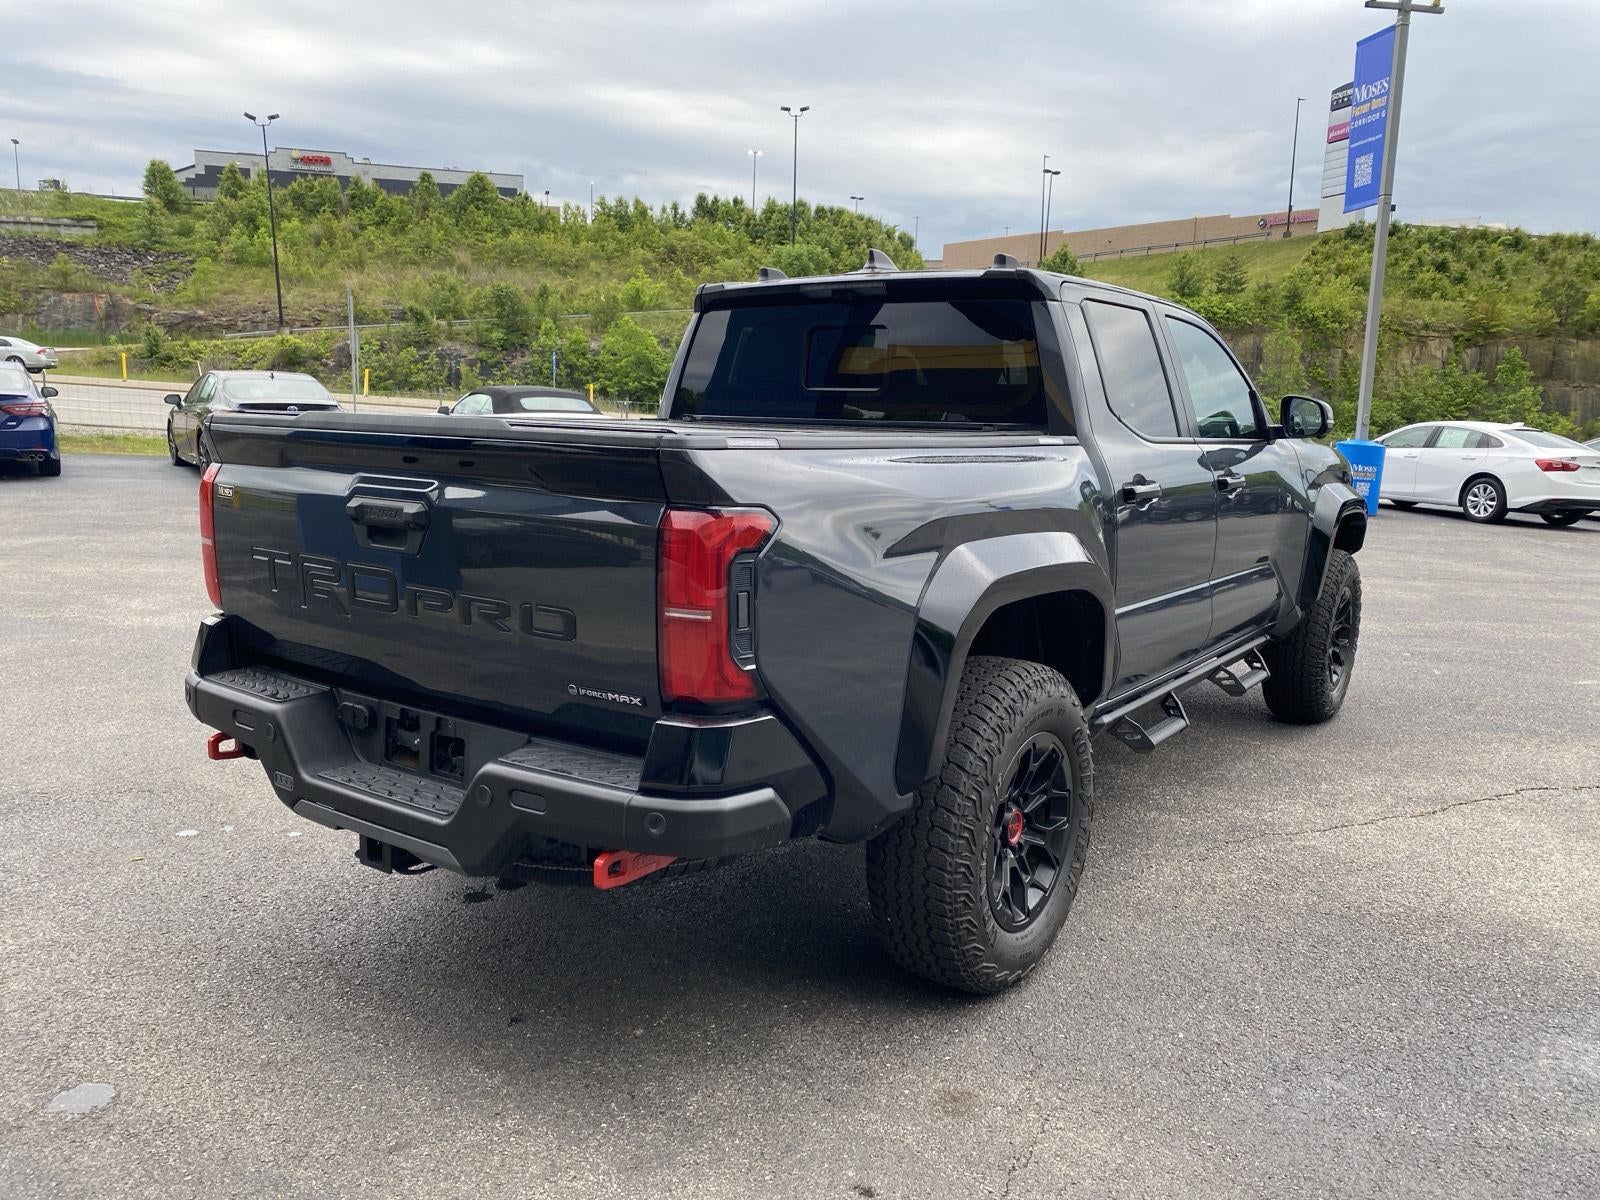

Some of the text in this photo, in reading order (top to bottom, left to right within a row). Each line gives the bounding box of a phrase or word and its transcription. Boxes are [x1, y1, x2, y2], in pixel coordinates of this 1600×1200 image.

[1351, 112, 1380, 129] CORRIDOR
[405, 585, 577, 643] PRO
[607, 692, 642, 707] MAX
